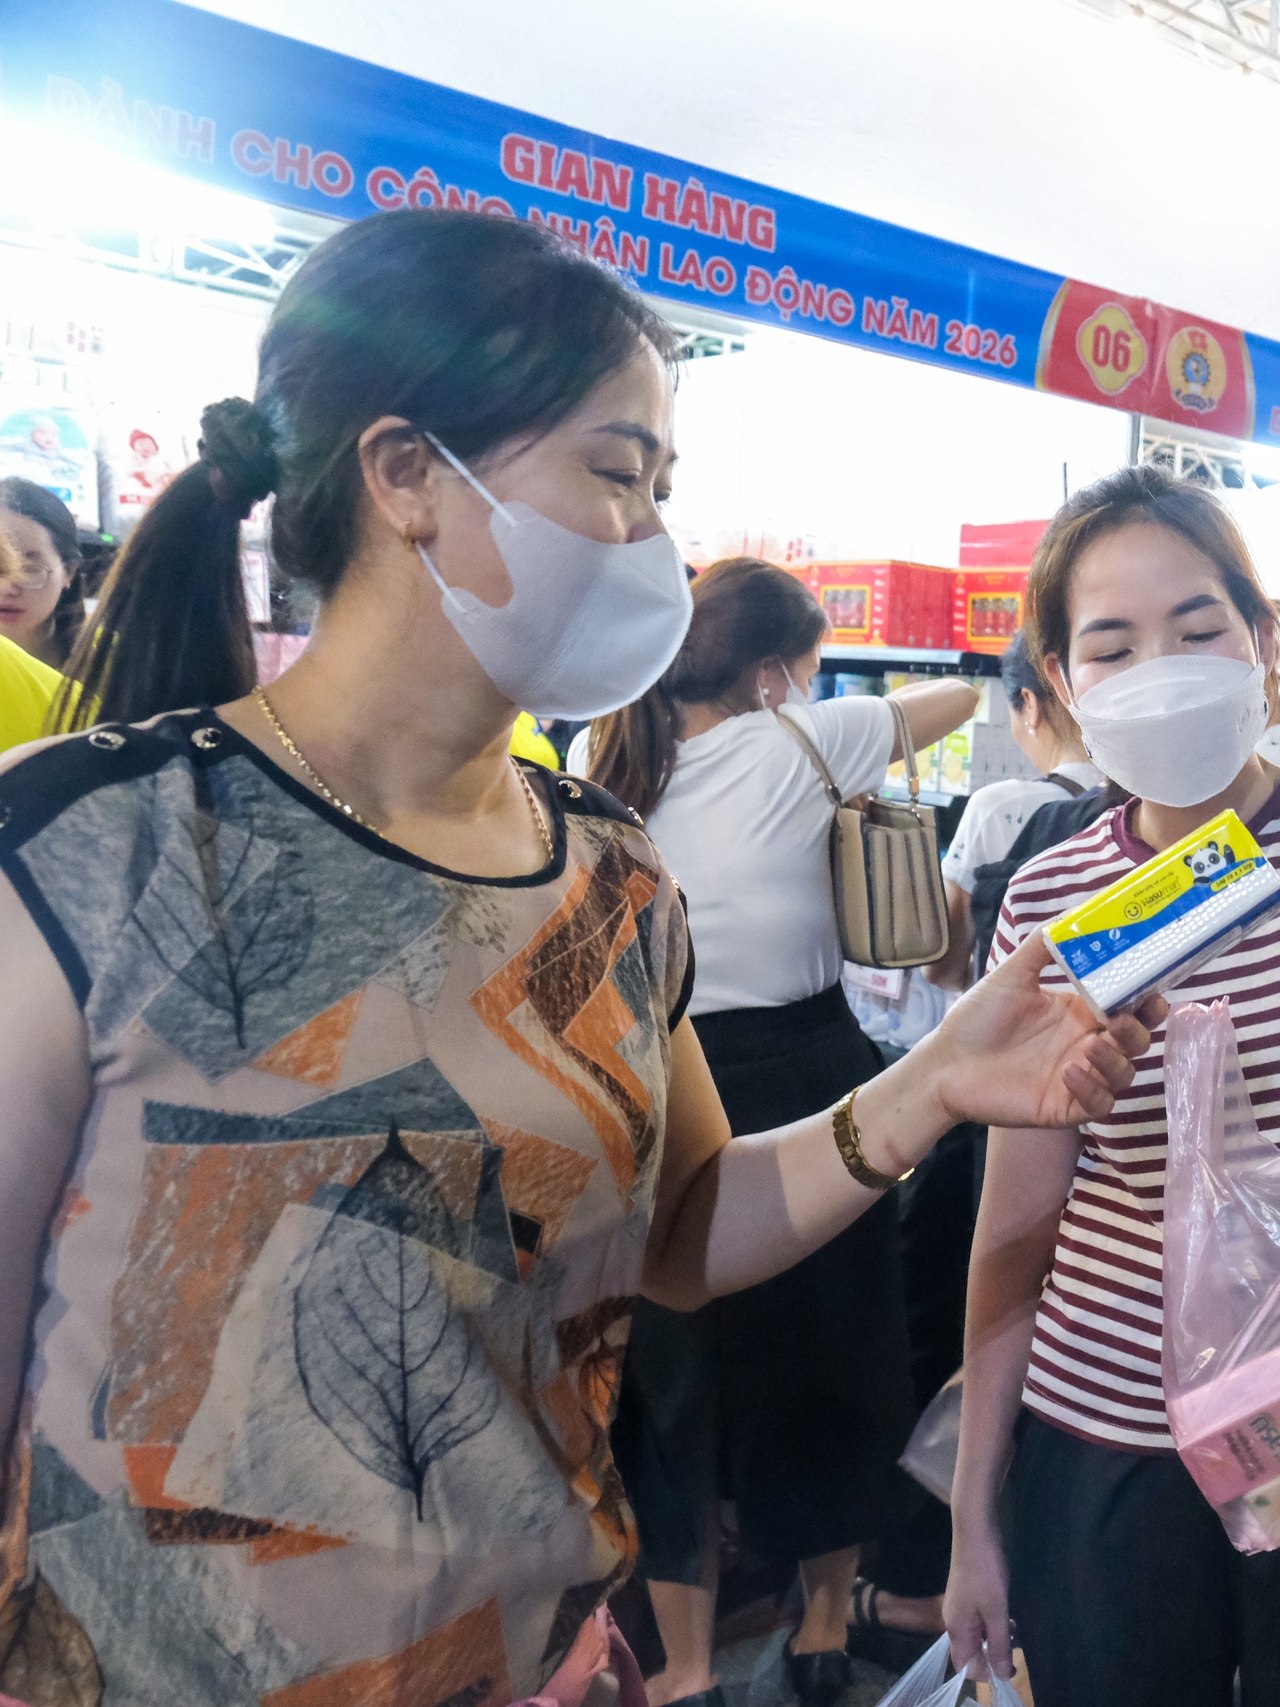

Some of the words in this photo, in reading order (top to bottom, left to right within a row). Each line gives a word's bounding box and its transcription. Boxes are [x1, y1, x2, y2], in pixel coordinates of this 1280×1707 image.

[45, 74, 216, 165] DÀNH
[231, 129, 355, 198] CHO
[659, 242, 737, 296] LAO
[745, 265, 855, 326] ĐỘNG
[862, 296, 939, 349] NĂM
[944, 318, 1018, 368] 2026
[501, 132, 633, 212] GIAN
[642, 172, 775, 253] HÀNG
[1091, 324, 1132, 373] 06
